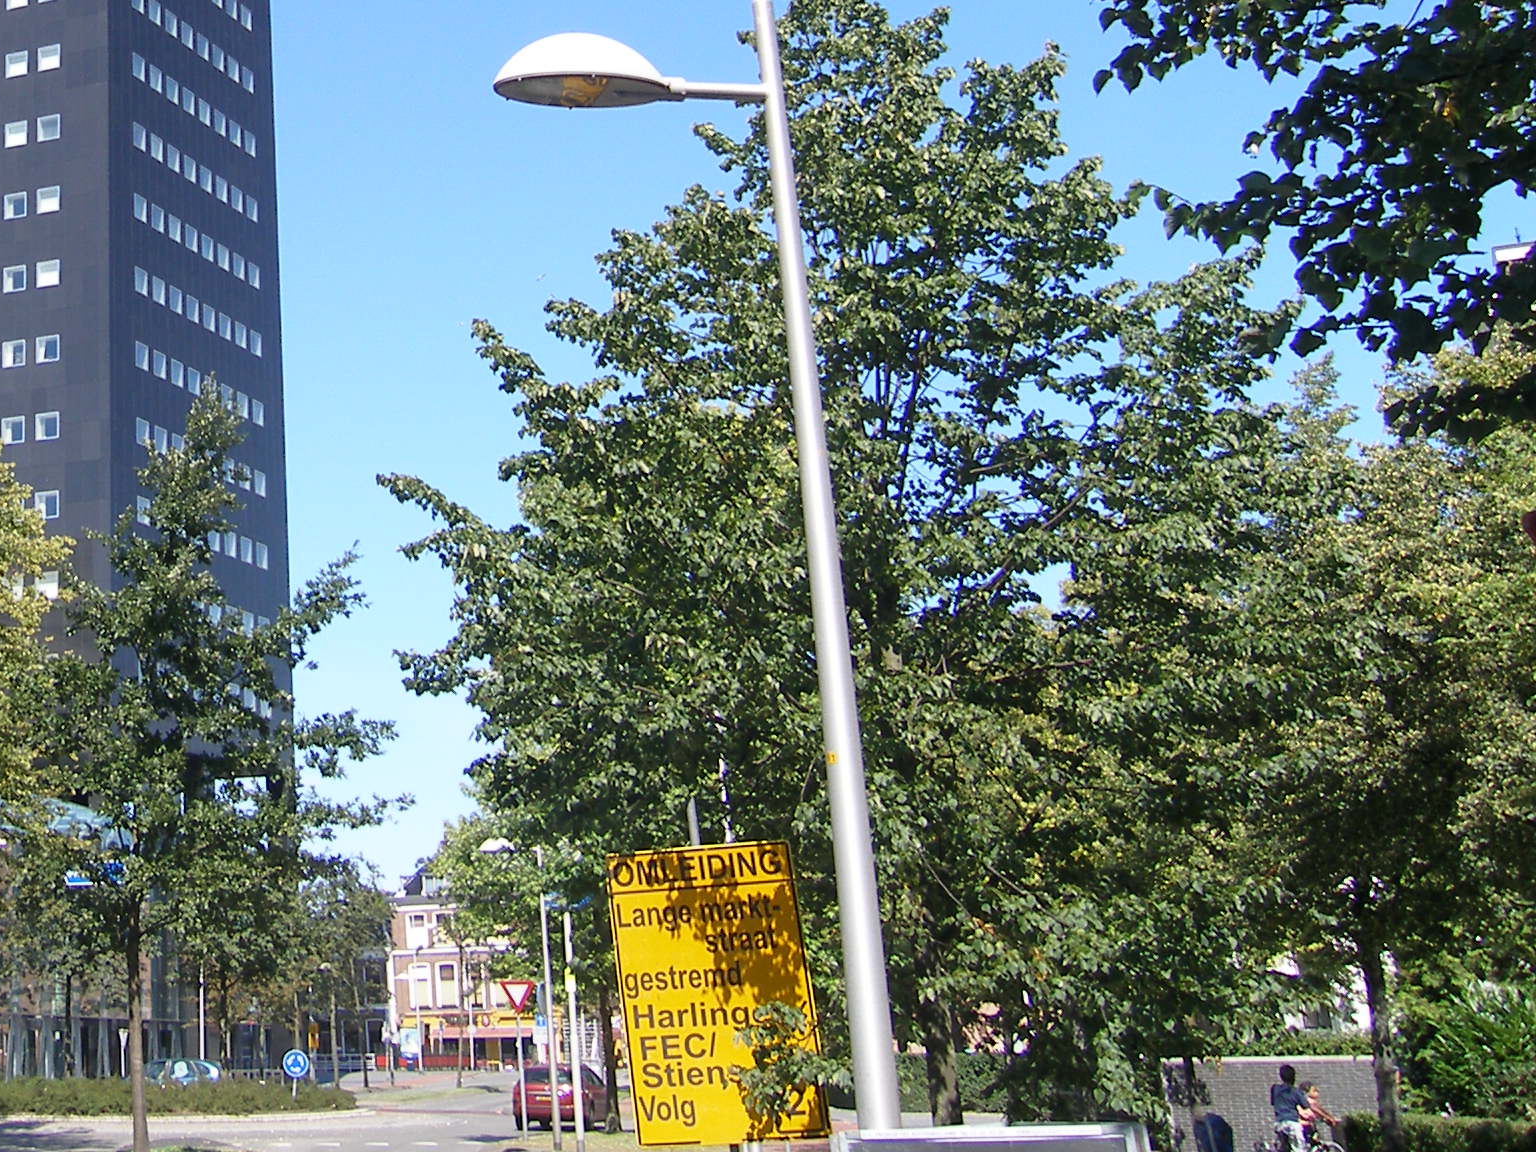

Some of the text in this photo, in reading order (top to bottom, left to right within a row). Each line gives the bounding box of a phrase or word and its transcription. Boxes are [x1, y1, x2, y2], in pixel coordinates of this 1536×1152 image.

[614, 849, 782, 887] OMLEIDING
[616, 893, 781, 932] Lange markt-
[705, 924, 779, 953] straat
[624, 960, 743, 999] gestremd
[639, 1031, 716, 1061] FEC/
[638, 1094, 696, 1127] Volg
